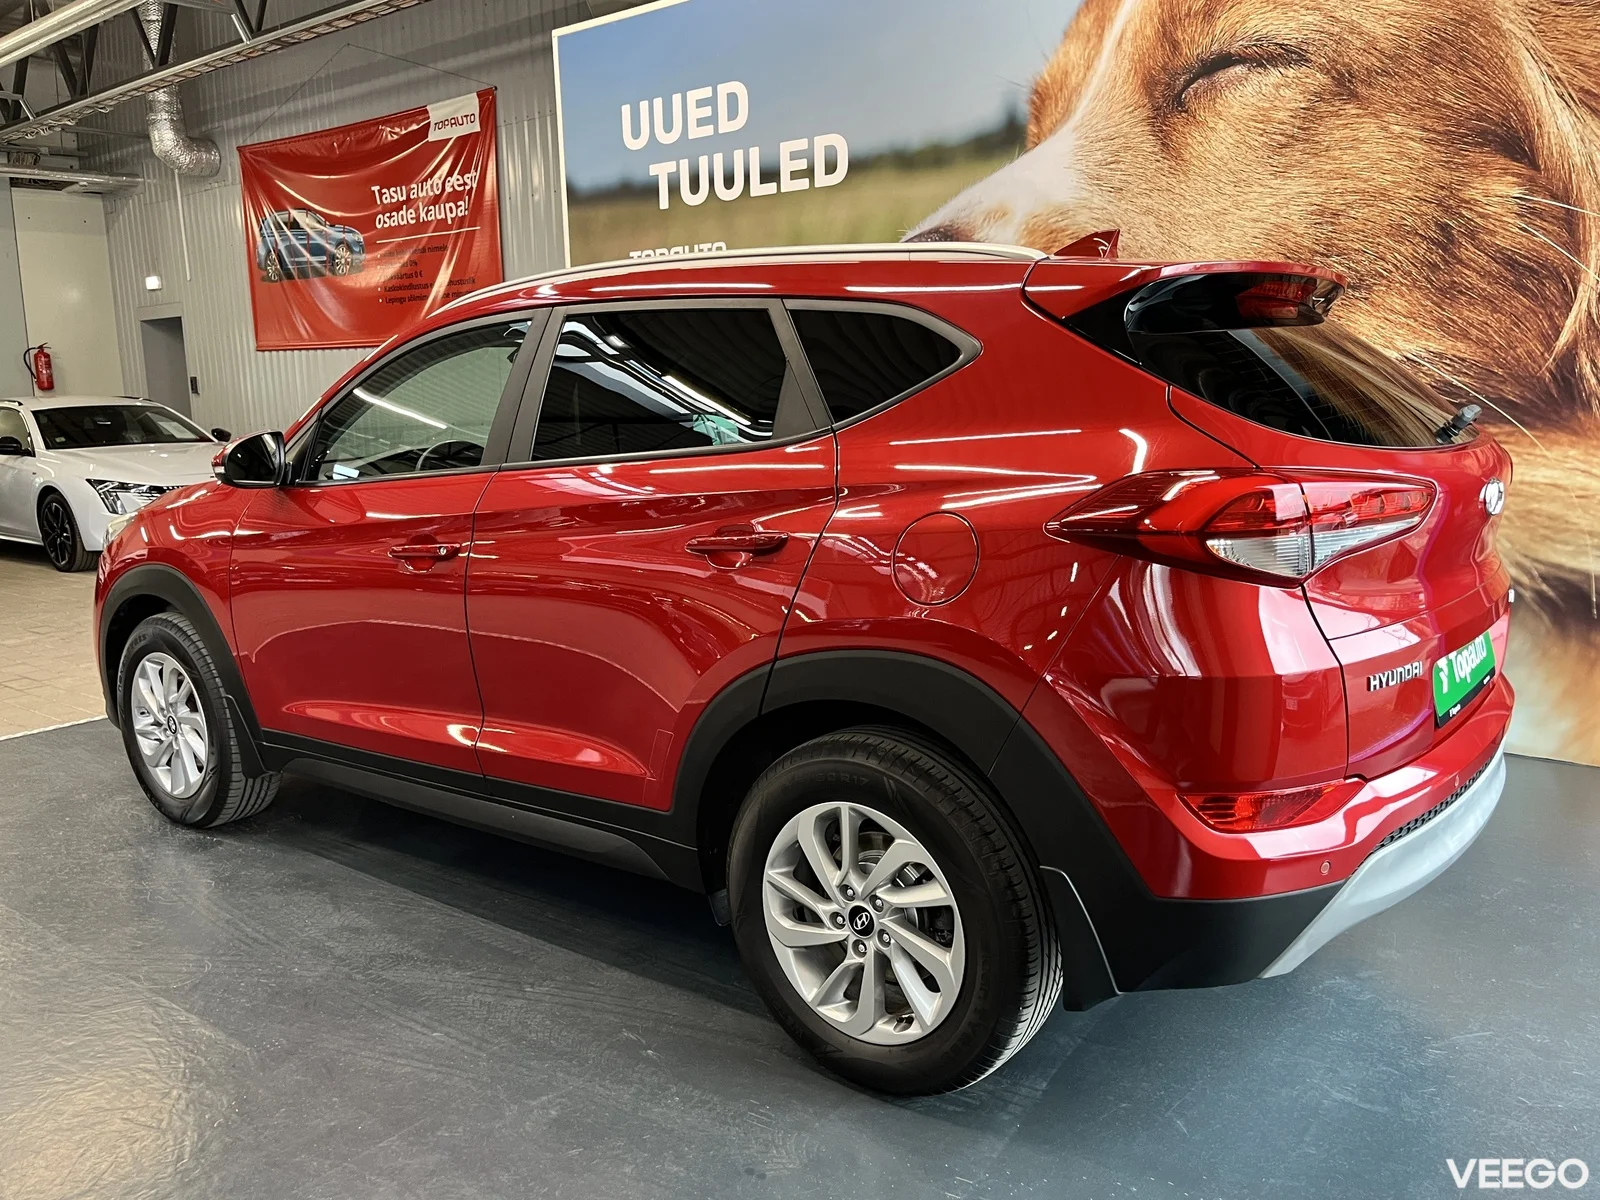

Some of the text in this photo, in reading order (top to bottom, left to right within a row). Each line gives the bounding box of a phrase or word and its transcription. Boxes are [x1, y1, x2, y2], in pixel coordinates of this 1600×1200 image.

[433, 113, 476, 132] TOPAUTO
[621, 80, 749, 151] UUED
[648, 133, 849, 210] TUULED
[371, 172, 477, 205] Tasu auto eest
[375, 195, 469, 229] osade kaupa!
[1367, 660, 1423, 692] HYUNDAI
